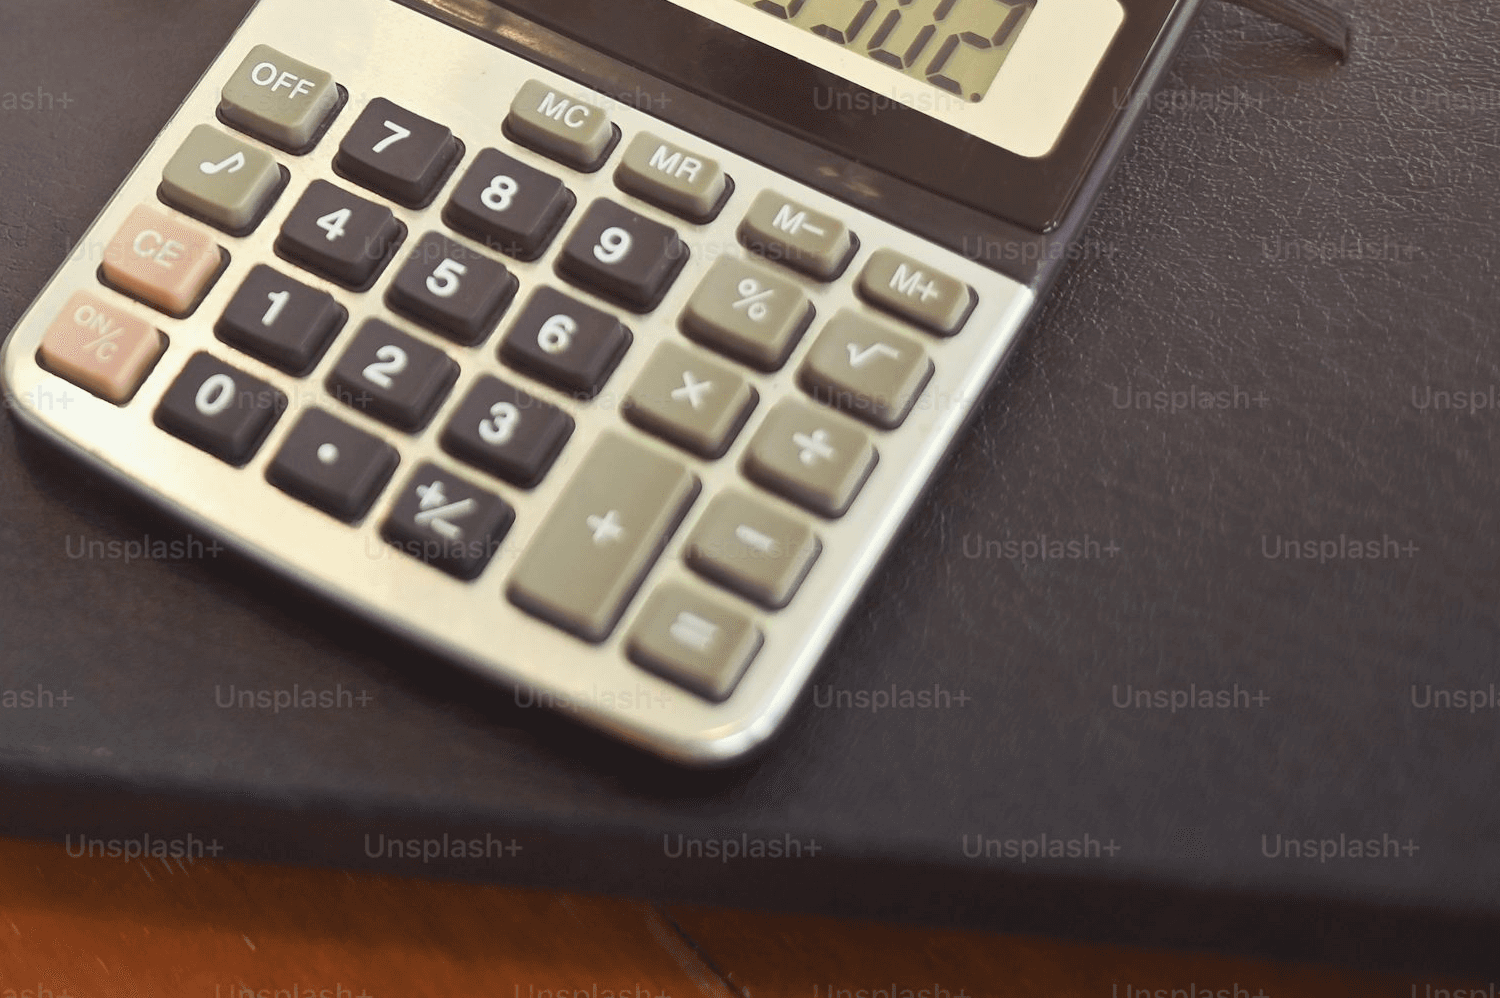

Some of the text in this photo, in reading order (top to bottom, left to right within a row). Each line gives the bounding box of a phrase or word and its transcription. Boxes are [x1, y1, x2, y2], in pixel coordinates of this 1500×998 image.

[251, 62, 315, 100] OFF
[536, 91, 589, 128] MC
[371, 120, 411, 153] 7
[649, 144, 702, 183] MR
[480, 175, 519, 211] 8
[316, 208, 352, 242] 4
[132, 229, 185, 268] CE
[593, 227, 632, 264] 9
[425, 258, 467, 297] 5
[888, 263, 939, 302] M+
[261, 290, 290, 327] 1
[731, 278, 775, 321] %
[537, 313, 578, 354] 6
[362, 344, 408, 389] 2
[194, 373, 236, 415] 0
[478, 401, 520, 446] 3
